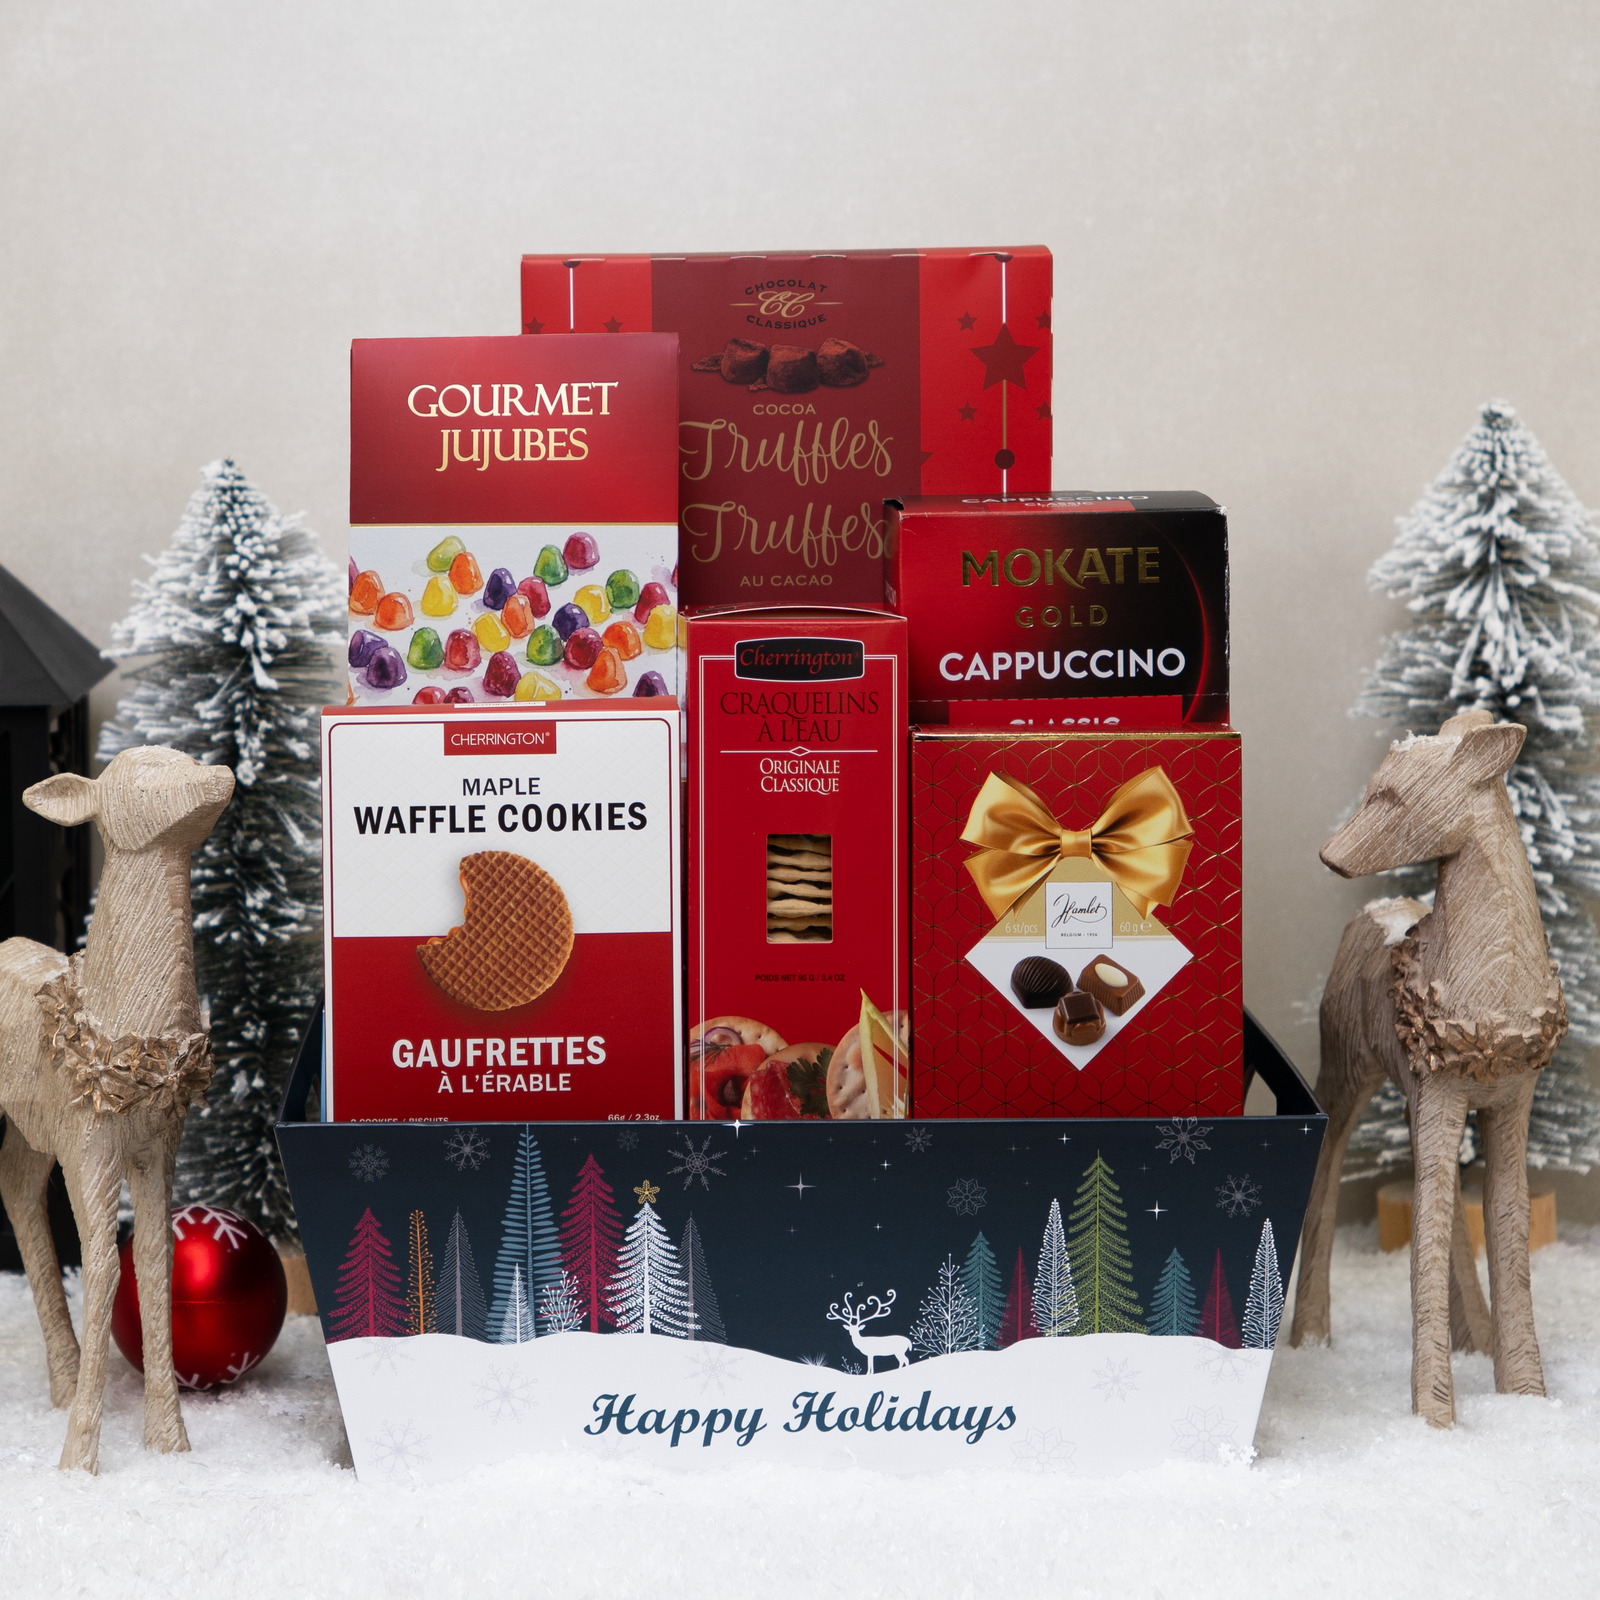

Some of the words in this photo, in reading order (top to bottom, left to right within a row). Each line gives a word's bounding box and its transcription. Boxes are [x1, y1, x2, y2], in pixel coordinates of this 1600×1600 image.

[745, 279, 827, 295] CHOCOLAT
[746, 314, 827, 330] CLASSIQUE
[407, 381, 618, 417] GOURMET
[753, 404, 816, 415] COCOA
[436, 427, 589, 472] JUJUBES
[678, 417, 893, 486] Truffles
[962, 495, 1149, 503] CAPPUCCINO
[682, 500, 886, 568] Truffes
[961, 547, 1160, 589] MOKATE
[740, 575, 764, 587] AU
[770, 574, 833, 586] CACAO
[1015, 605, 1108, 628] GOLD
[939, 648, 1186, 681] CAPPUCCINO
[720, 692, 879, 719] CRAQUELINS
[757, 715, 774, 742] À
[781, 719, 841, 742] L'EAU
[759, 758, 840, 774] ORIGINALE
[462, 777, 541, 796] MAPLE
[760, 776, 840, 795] CLASSIQUE
[354, 804, 486, 834] WAFFLE
[498, 802, 647, 832] COOKIES
[1051, 893, 1108, 929] Hamlet
[1005, 923, 1012, 933] 6
[1012, 922, 1038, 935] st/pcs
[1120, 922, 1131, 933] 60
[755, 974, 779, 982] POIDS
[781, 974, 796, 982] NET
[798, 974, 807, 982] 95
[808, 974, 815, 982] G
[821, 974, 833, 982] 3.4
[834, 974, 845, 982] OZ
[392, 1036, 606, 1068] GAUFRETTES
[438, 1071, 453, 1093] À
[461, 1070, 571, 1093] L'ÉRABLE
[635, 1113, 660, 1121] 2.3oz
[583, 1393, 767, 1447] Happy
[783, 1390, 1017, 1445] Holidays
